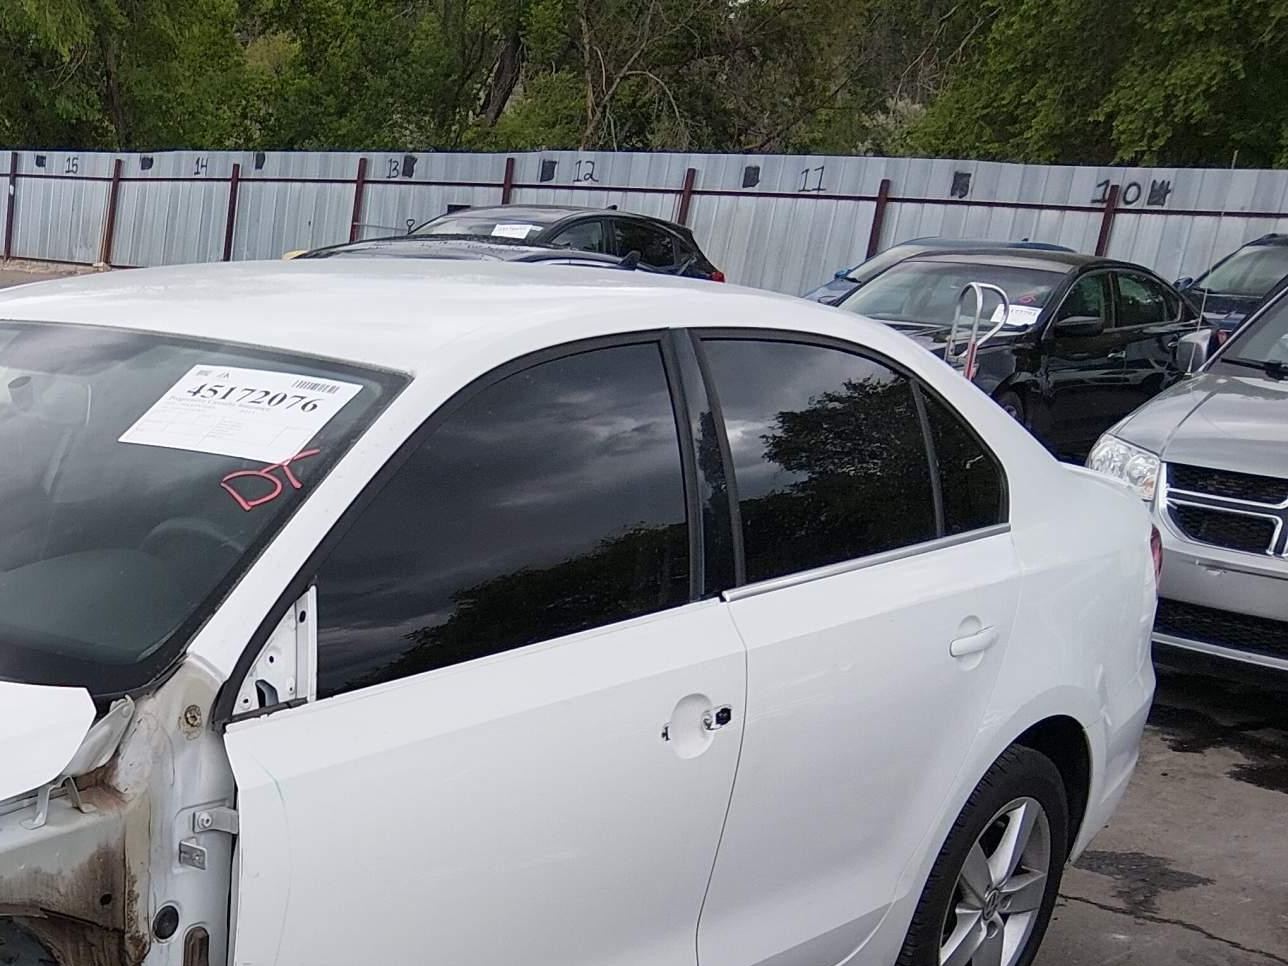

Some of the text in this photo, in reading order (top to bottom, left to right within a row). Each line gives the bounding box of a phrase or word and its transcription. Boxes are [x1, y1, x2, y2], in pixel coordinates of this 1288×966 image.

[65, 157, 79, 174] 15
[194, 158, 208, 176] 14
[386, 158, 400, 179] 13
[573, 160, 599, 183] 12
[798, 166, 826, 192] 11
[187, 383, 325, 413] 45172076
